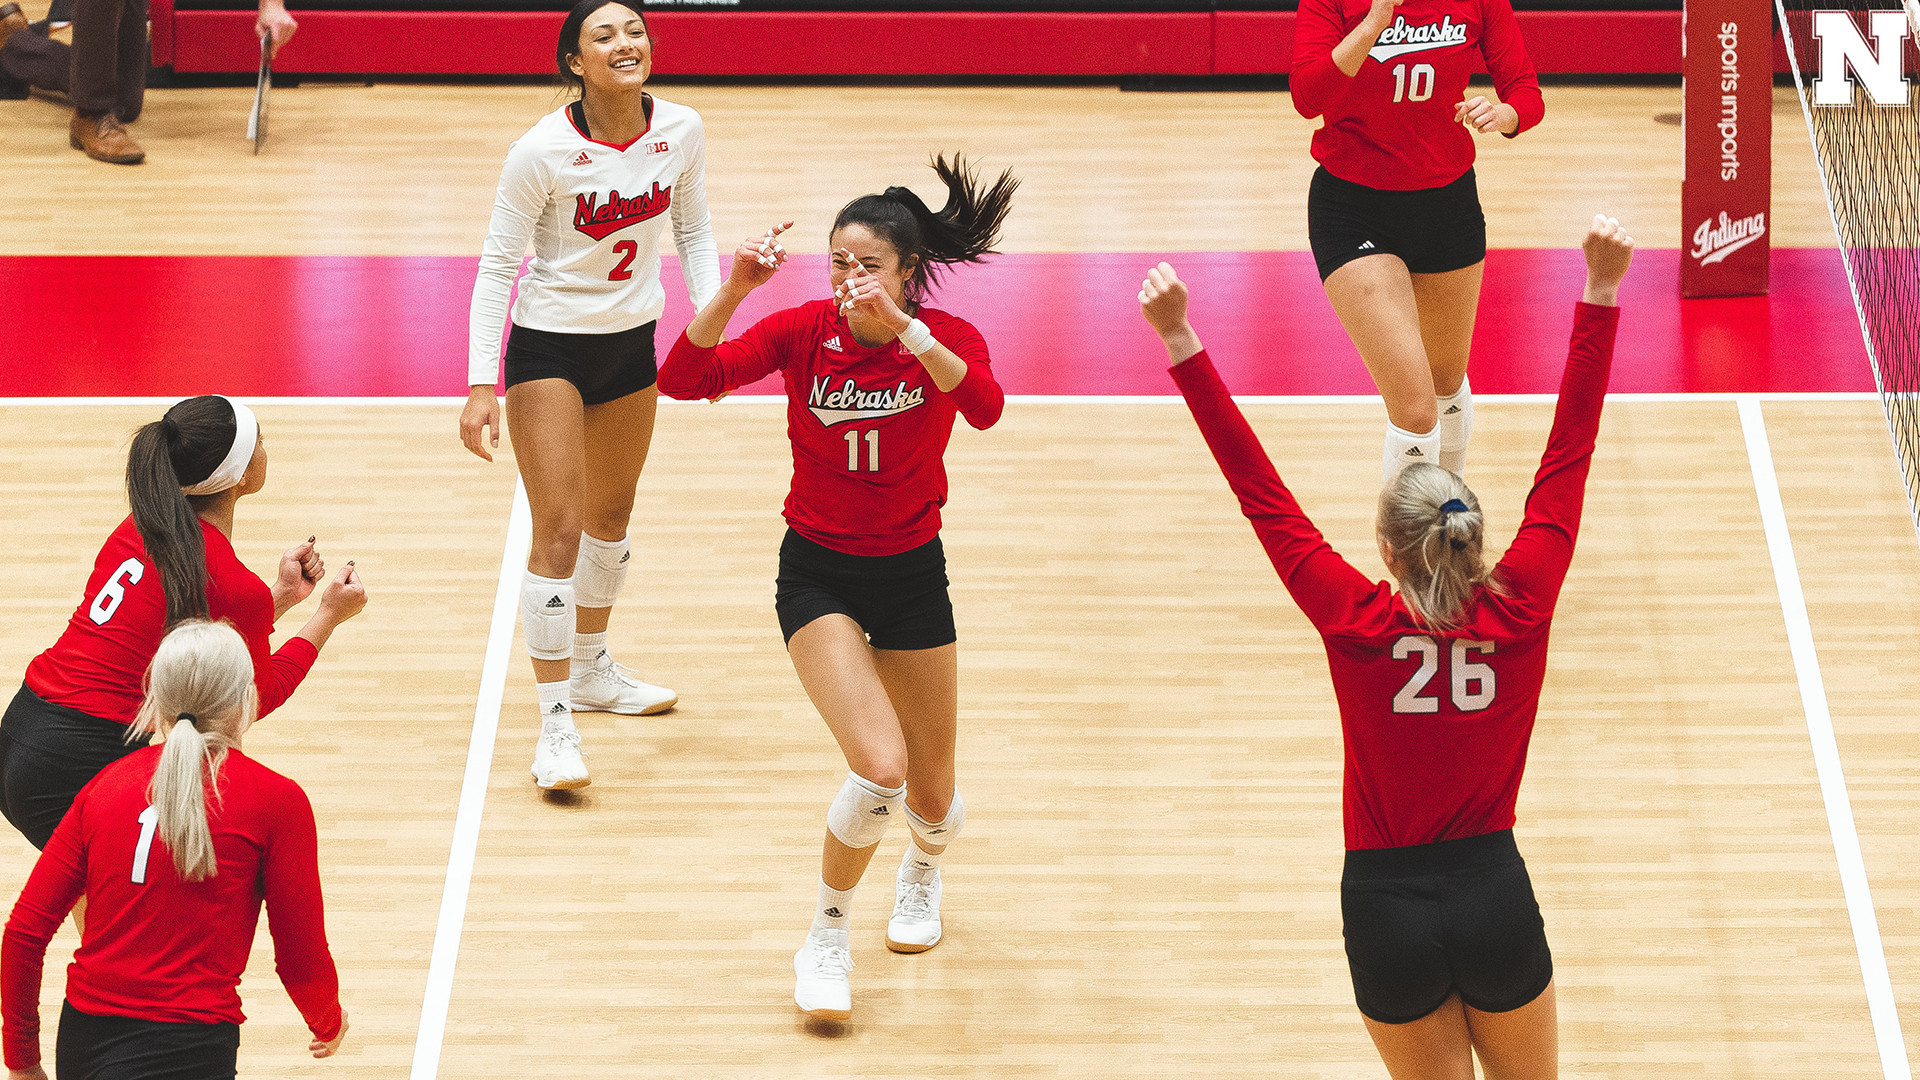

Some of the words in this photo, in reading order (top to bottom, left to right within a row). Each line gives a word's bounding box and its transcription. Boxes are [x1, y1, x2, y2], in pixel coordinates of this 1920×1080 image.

[1374, 14, 1467, 45] ebraska
[1717, 21, 1741, 92] sports
[1391, 63, 1436, 103] 10
[1717, 95, 1741, 182] imports
[573, 181, 672, 227] Nebraska
[1690, 210, 1766, 260] Indiana
[607, 239, 639, 282] 2
[822, 340, 843, 353] adidas
[807, 372, 926, 410] Nebraska
[843, 429, 880, 473] 11
[88, 556, 146, 627] 6
[1391, 633, 1497, 714] 26
[130, 803, 160, 885] 1
